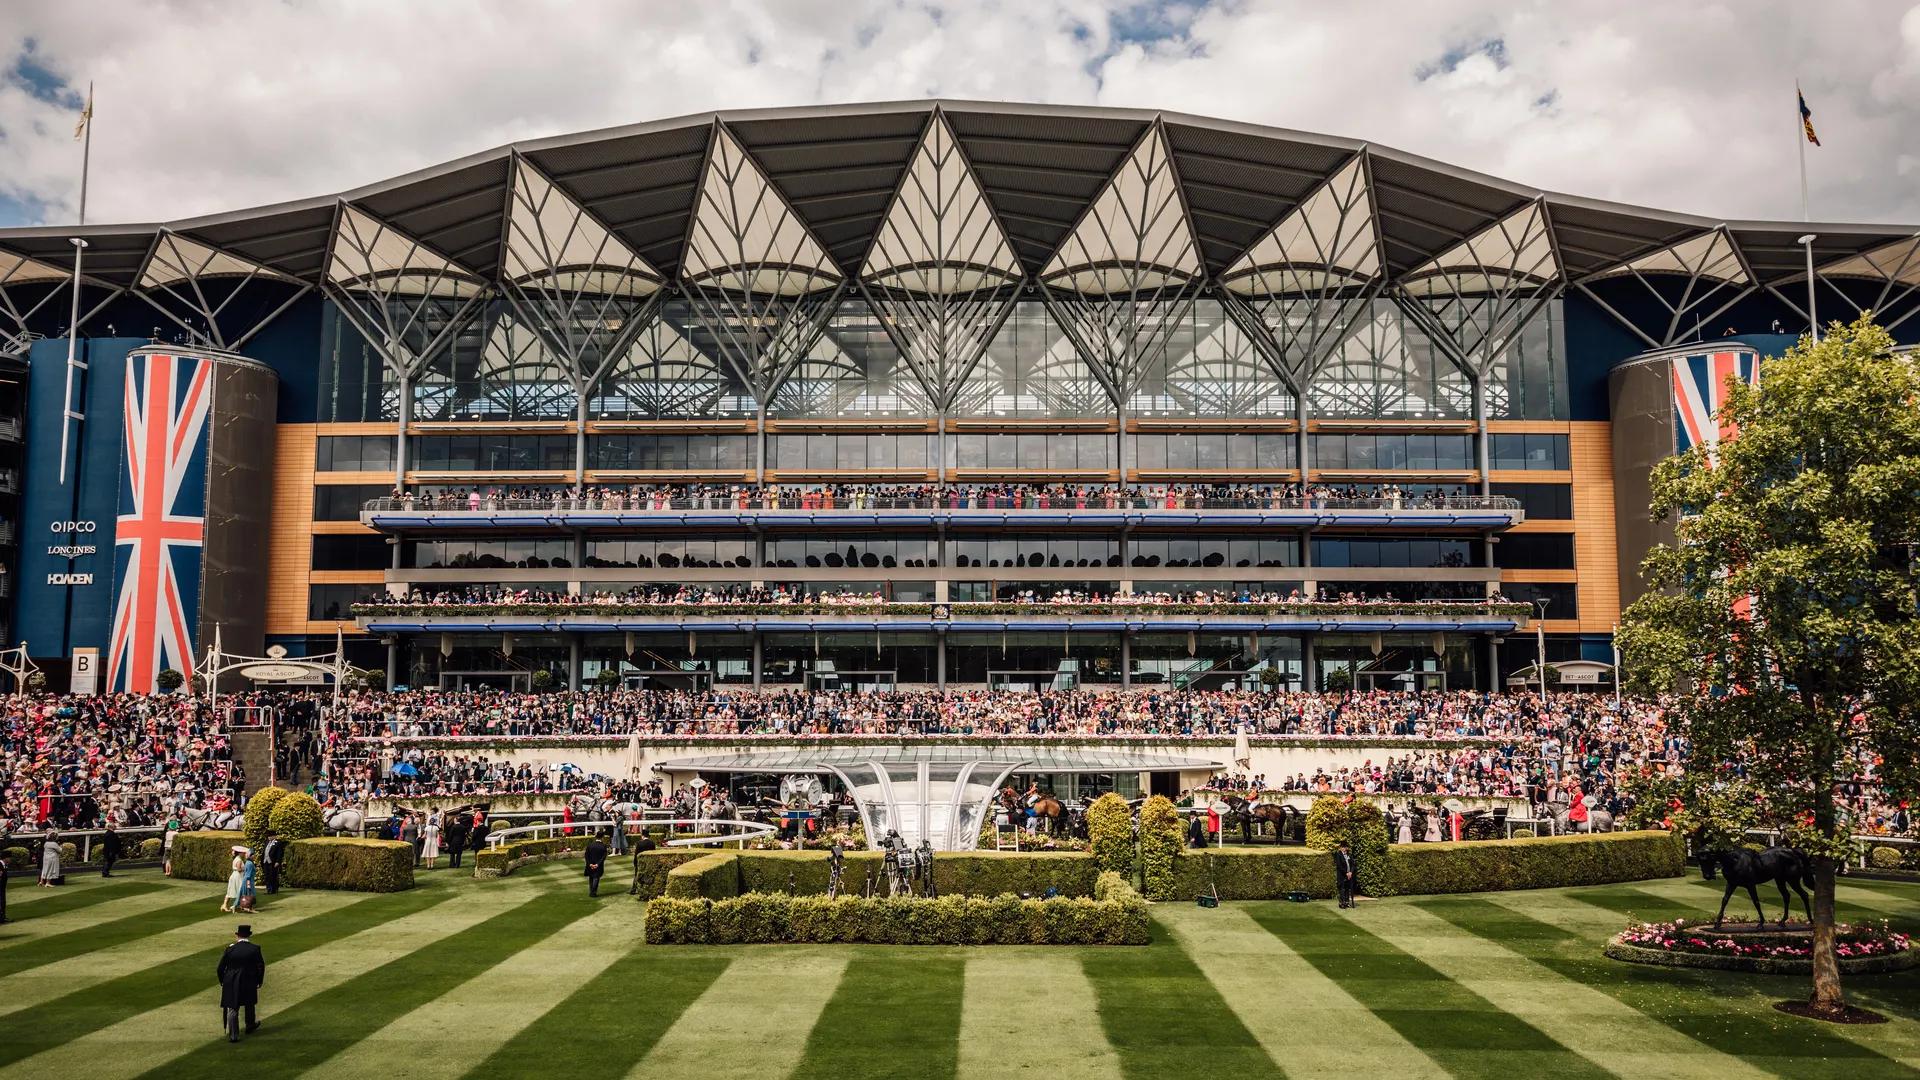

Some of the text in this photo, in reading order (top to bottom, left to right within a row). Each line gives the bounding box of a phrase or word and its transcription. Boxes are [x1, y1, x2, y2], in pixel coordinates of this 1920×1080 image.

[50, 521, 96, 533] QIPCO
[47, 545, 96, 555] LONGINES
[47, 573, 93, 585] HOWDEN
[78, 656, 89, 671] B
